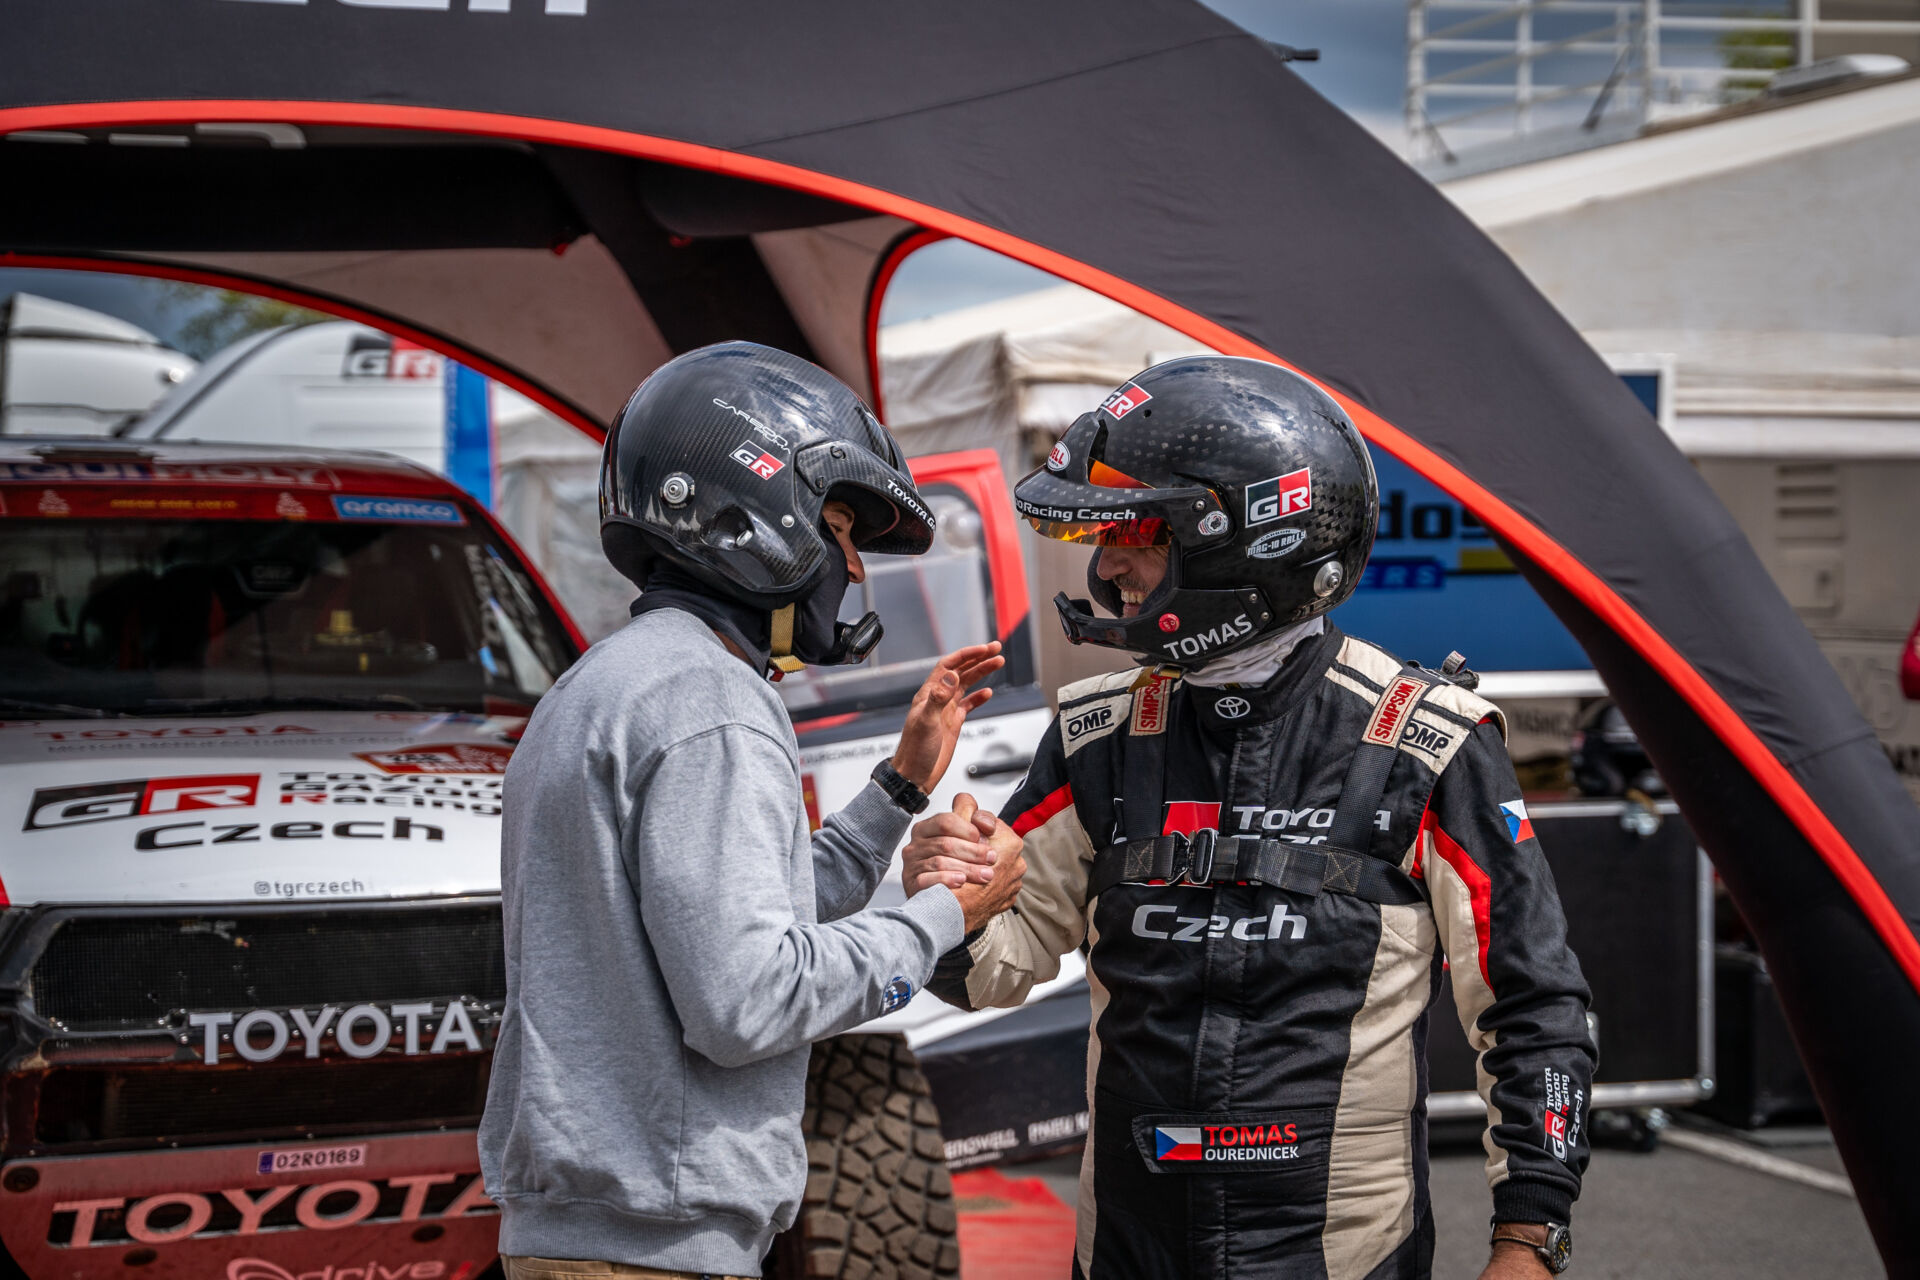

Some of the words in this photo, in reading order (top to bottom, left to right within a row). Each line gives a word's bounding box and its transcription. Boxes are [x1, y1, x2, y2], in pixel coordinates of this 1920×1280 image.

[713, 398, 788, 447] CARBON
[733, 449, 775, 478] GR
[342, 501, 452, 518] aramco
[888, 479, 928, 520] TOYOTA
[1024, 502, 1073, 522] Racing
[1077, 509, 1137, 520] Czech
[1249, 486, 1309, 522] GR
[1163, 613, 1253, 660] TOMAS
[1068, 708, 1112, 737] OMP
[1374, 682, 1417, 740] SIMPSON
[33, 724, 318, 742] TOYOTA
[1403, 722, 1449, 752] OMP
[33, 785, 253, 829] GR
[135, 817, 444, 852] Czech
[1131, 904, 1308, 941] Czech
[189, 1001, 482, 1065] TOYOTA
[1204, 1123, 1299, 1147] TOMAS
[1567, 1089, 1583, 1148] Czech
[1204, 1146, 1300, 1161] OUREDNICEK
[1551, 1115, 1566, 1159] GR
